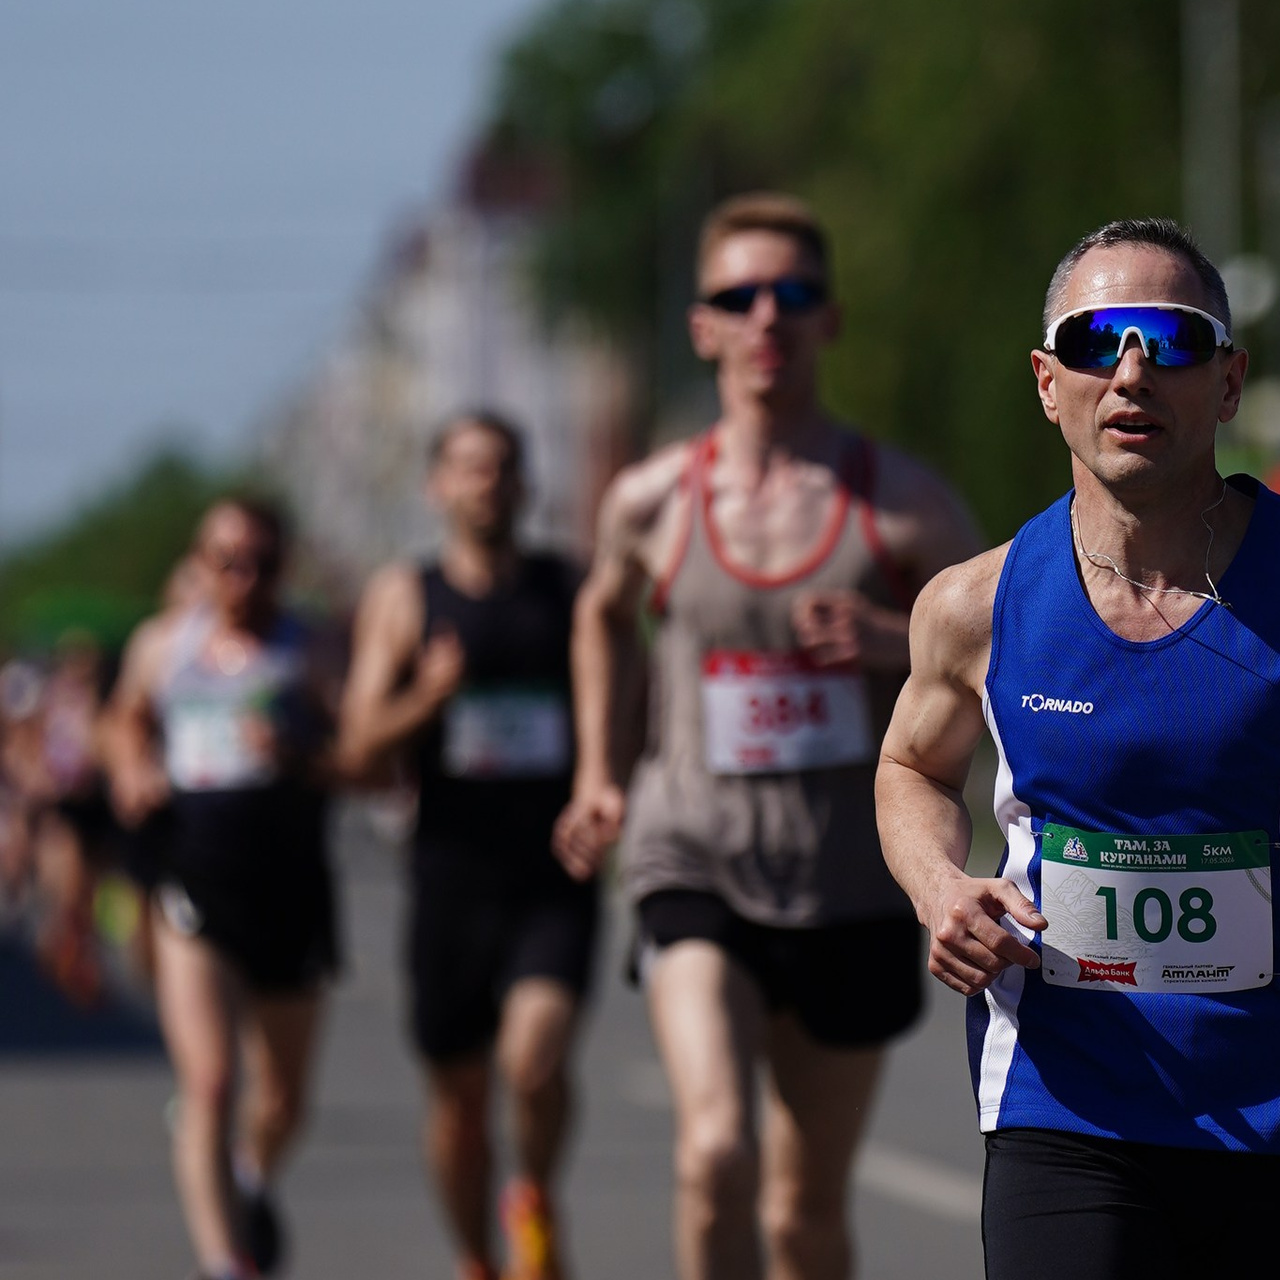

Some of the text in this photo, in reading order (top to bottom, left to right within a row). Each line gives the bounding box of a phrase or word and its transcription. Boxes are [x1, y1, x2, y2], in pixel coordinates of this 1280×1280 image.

[1021, 693, 1094, 714] TORNADO
[1113, 838, 1171, 853] ТАМ, ЗА
[1100, 851, 1187, 866] КУРГАНАМИ
[1095, 886, 1217, 943] 108
[1084, 966, 1130, 977] Альфа Банк
